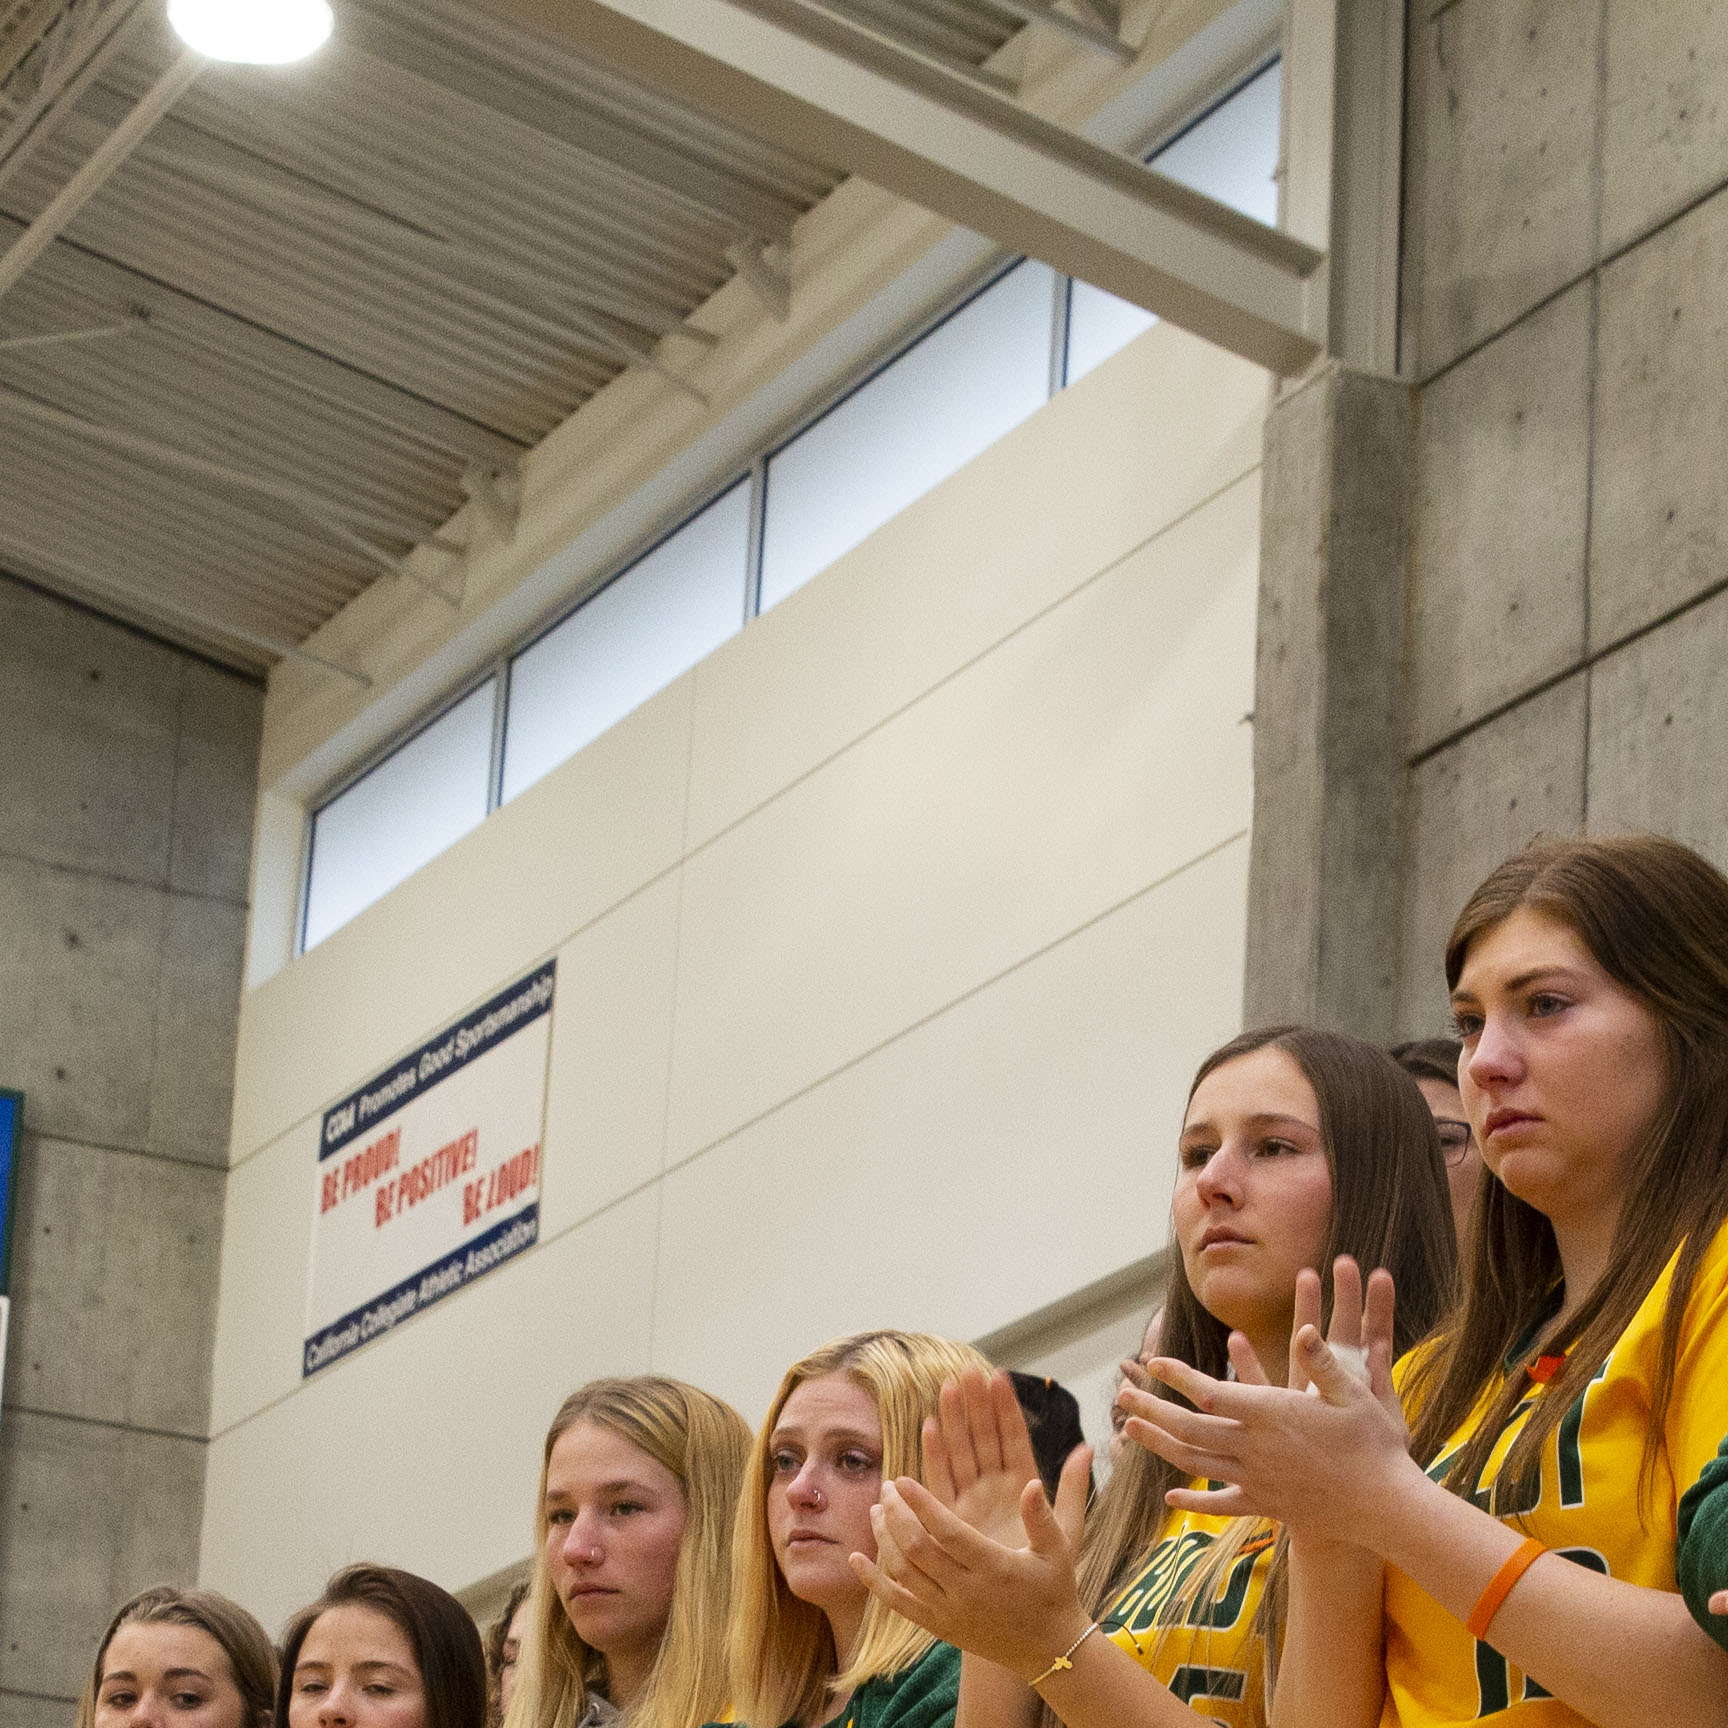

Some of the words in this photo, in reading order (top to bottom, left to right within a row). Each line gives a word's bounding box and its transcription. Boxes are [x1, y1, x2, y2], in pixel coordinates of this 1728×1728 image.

[419, 1036, 454, 1081] Good
[320, 1167, 339, 1215] BE
[342, 1127, 401, 1200] PROUD!
[375, 1181, 394, 1228] BE
[397, 1127, 479, 1215] POSITIVE!
[463, 1175, 484, 1227] BE
[485, 1143, 541, 1212] LOUD!
